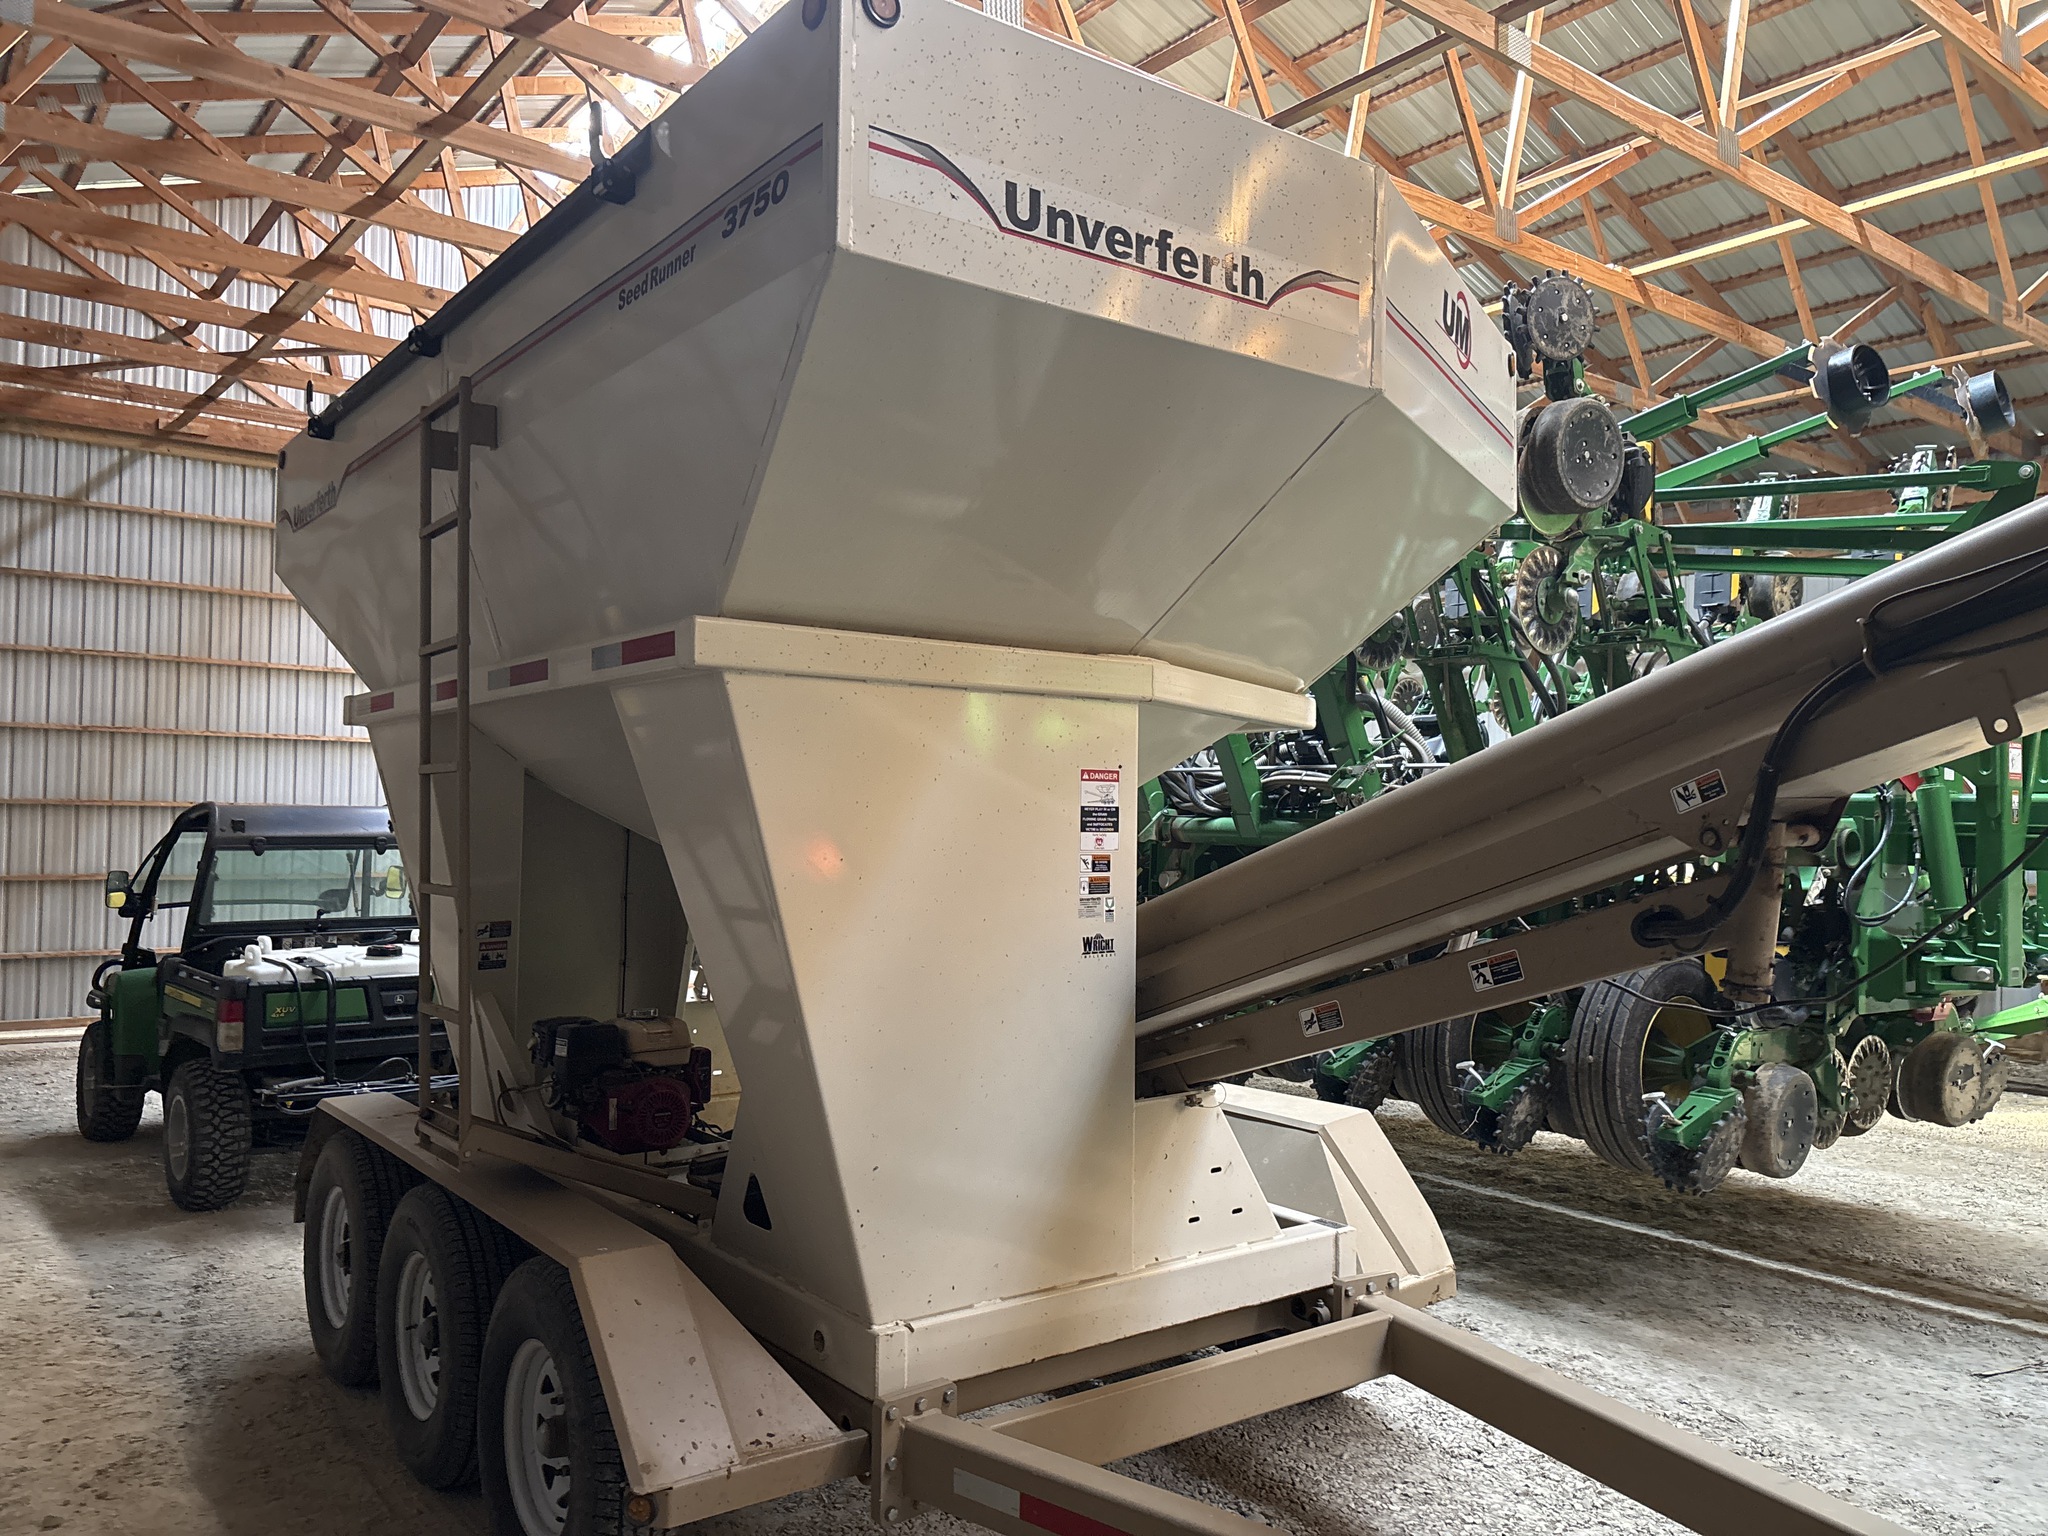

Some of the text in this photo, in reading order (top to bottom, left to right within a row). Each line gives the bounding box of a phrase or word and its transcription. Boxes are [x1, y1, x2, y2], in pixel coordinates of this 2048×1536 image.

[721, 170, 790, 239] 3750
[1005, 180, 1265, 301] Unverferth
[1090, 772, 1118, 780] DANGER
[1082, 936, 1115, 952] WRIGHT
